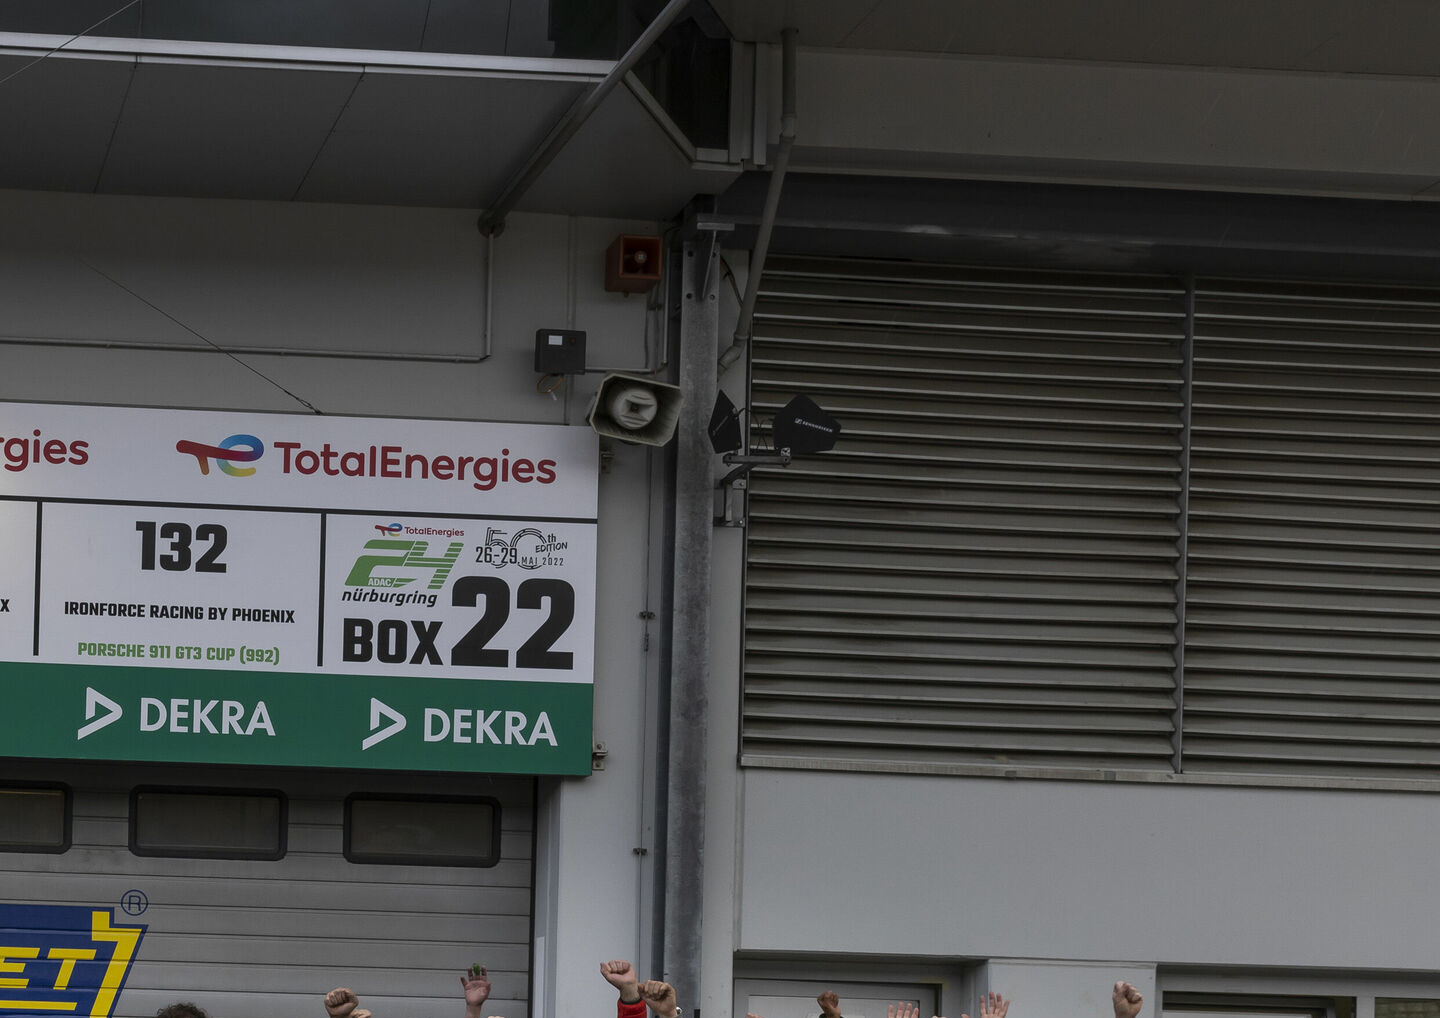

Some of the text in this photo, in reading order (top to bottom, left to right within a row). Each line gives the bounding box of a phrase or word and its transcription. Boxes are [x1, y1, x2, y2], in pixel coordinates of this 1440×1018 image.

[274, 441, 557, 490] TotalEnergies
[404, 526, 465, 538] TotalEnergies
[135, 521, 228, 574] 132
[535, 541, 568, 553] EDITION
[521, 556, 538, 566] MAI
[542, 556, 564, 567] 2022
[368, 577, 392, 587] ADAC
[342, 588, 438, 607] nürburgring
[64, 601, 295, 624] IRONFORCE RACING BY PHOENIX
[343, 576, 575, 670] BOX 22
[78, 642, 280, 666] PORSCHE 911 GT3 CUP (992)
[139, 697, 277, 737] DEKRA
[423, 708, 558, 748] DEKRA
